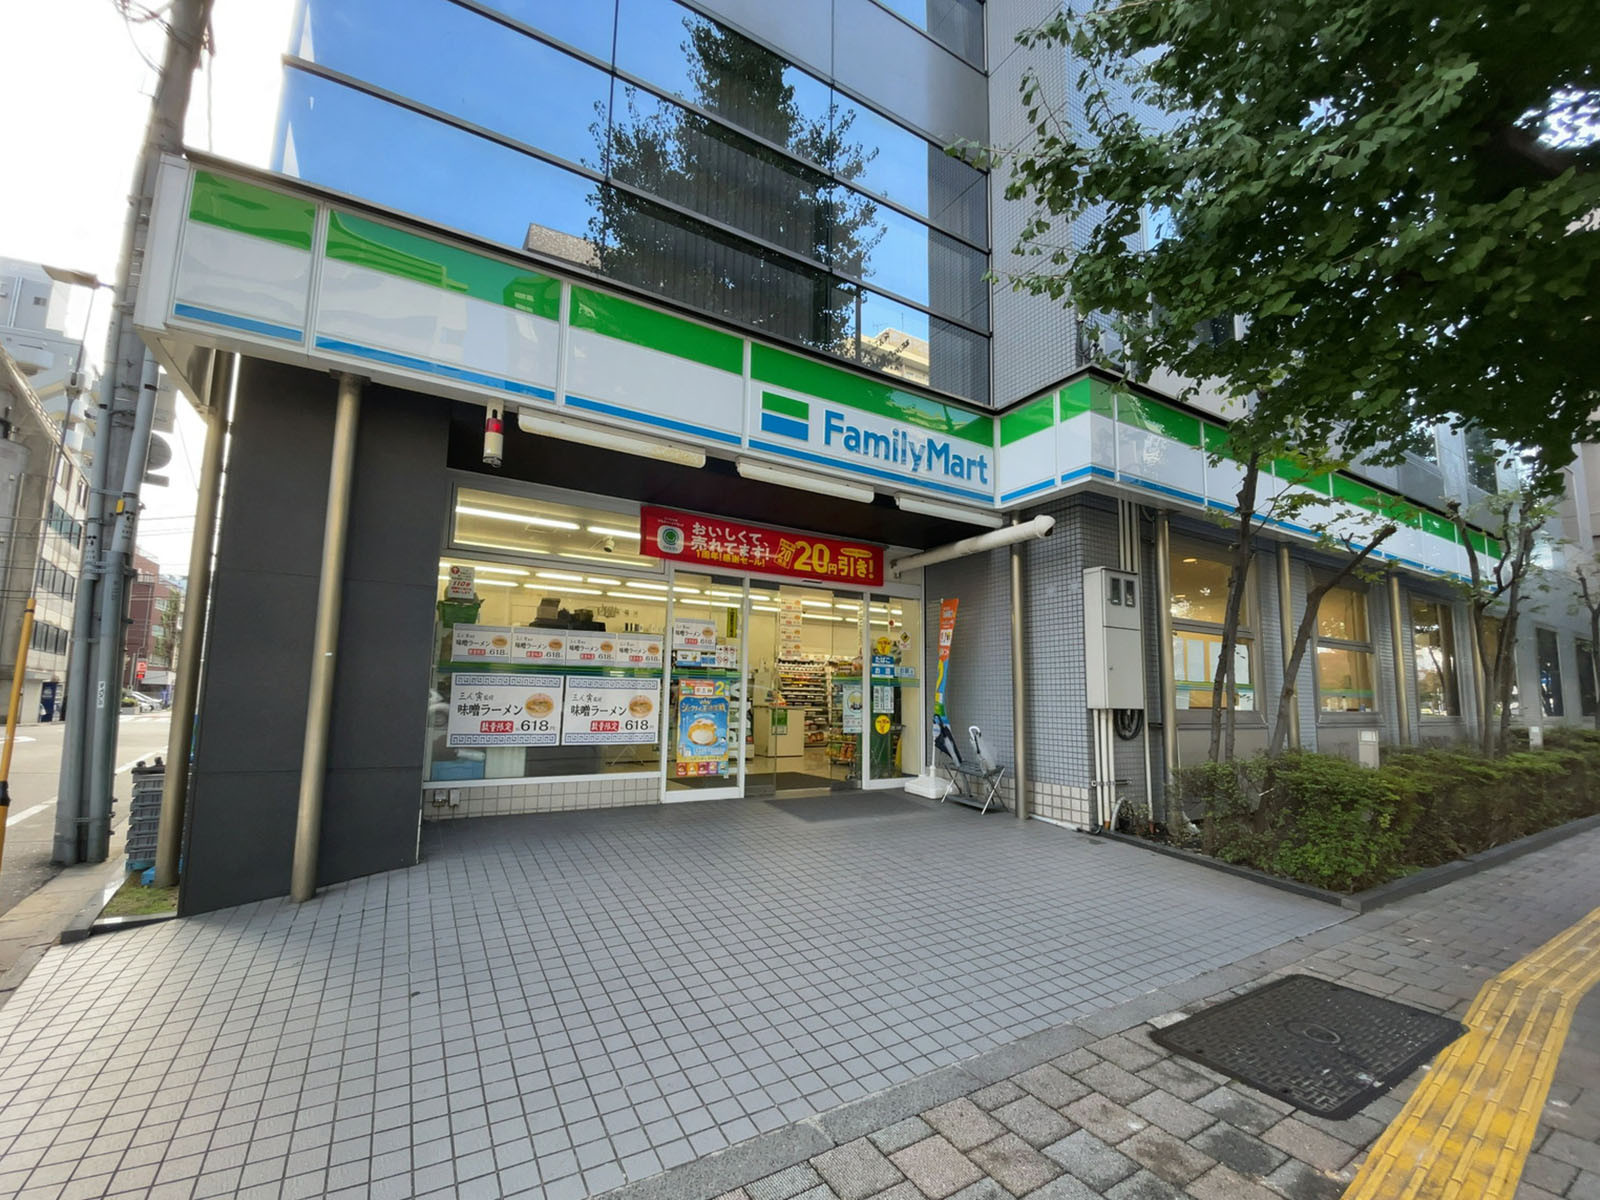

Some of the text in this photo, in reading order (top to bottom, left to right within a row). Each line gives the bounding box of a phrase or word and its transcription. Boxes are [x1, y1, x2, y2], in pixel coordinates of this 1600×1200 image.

[824, 409, 988, 485] FamilyMart
[692, 522, 769, 547] おいしくて、
[457, 703, 523, 716] 味噌ラーメン
[570, 704, 627, 717] 味噌ラーメン
